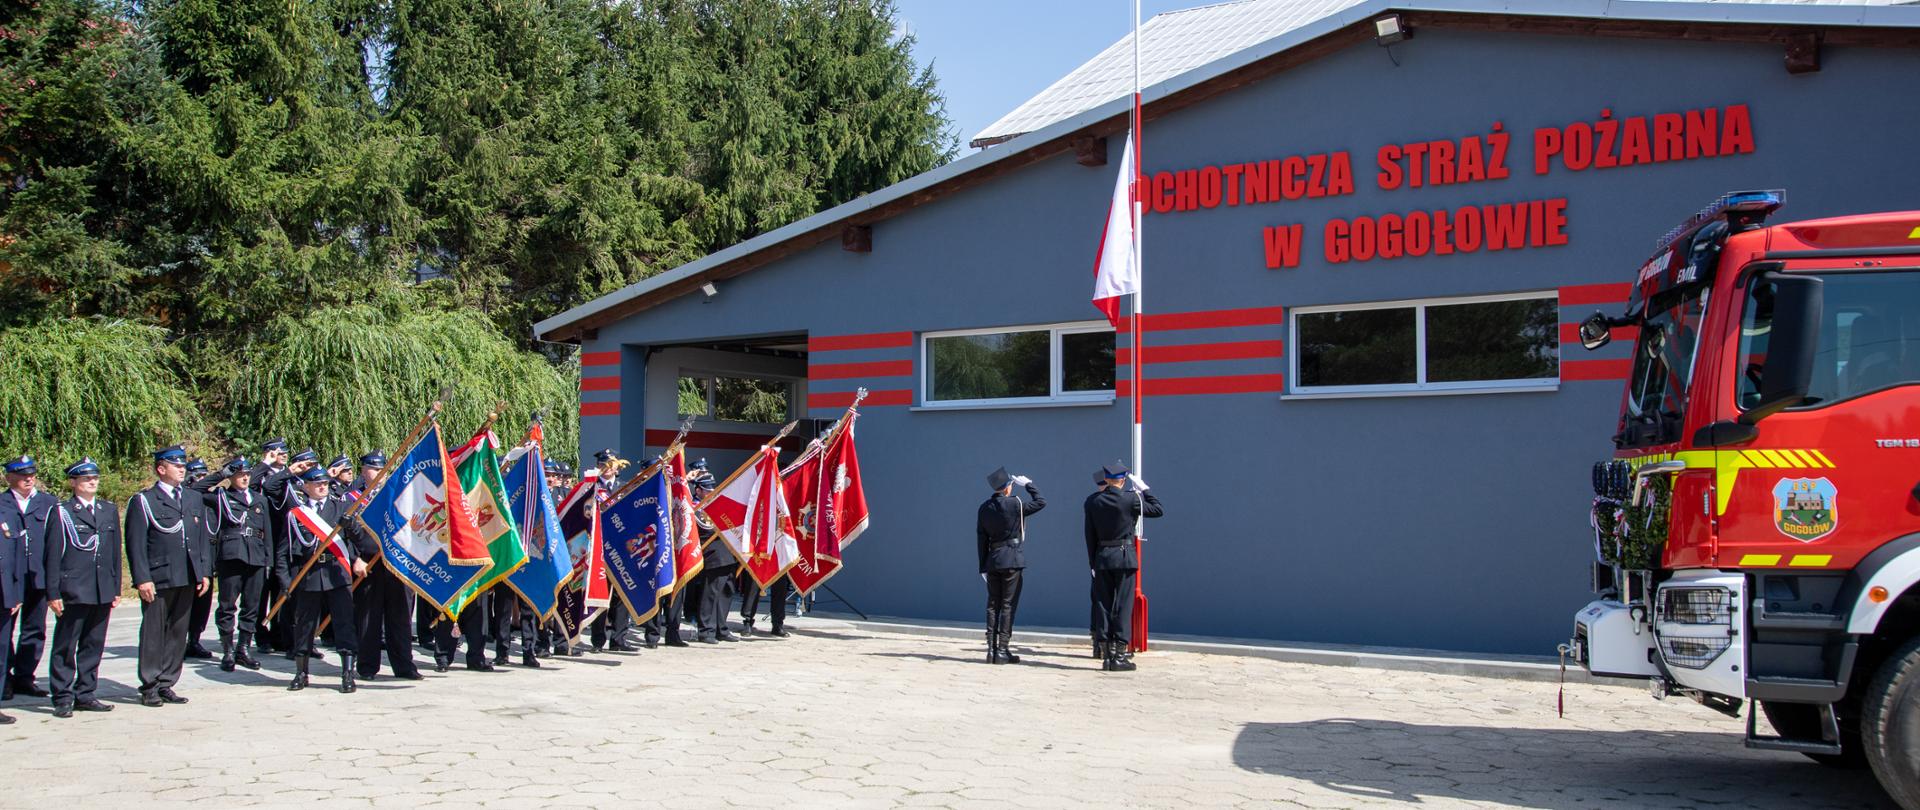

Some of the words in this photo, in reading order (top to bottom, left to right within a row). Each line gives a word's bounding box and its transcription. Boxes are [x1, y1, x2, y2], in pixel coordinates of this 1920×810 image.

[1377, 122, 1510, 190] STRAŻ
[1534, 104, 1756, 175] POŻARNA
[1263, 224, 1304, 269] W
[1324, 198, 1568, 264] GOGOŁOWIE
[1676, 265, 1697, 284] EMIL
[1875, 439, 1904, 448] TGM
[384, 511, 396, 533] 1908
[610, 512, 626, 533] 1961
[428, 562, 453, 583] 2005
[608, 547, 637, 591] WIDACZU
